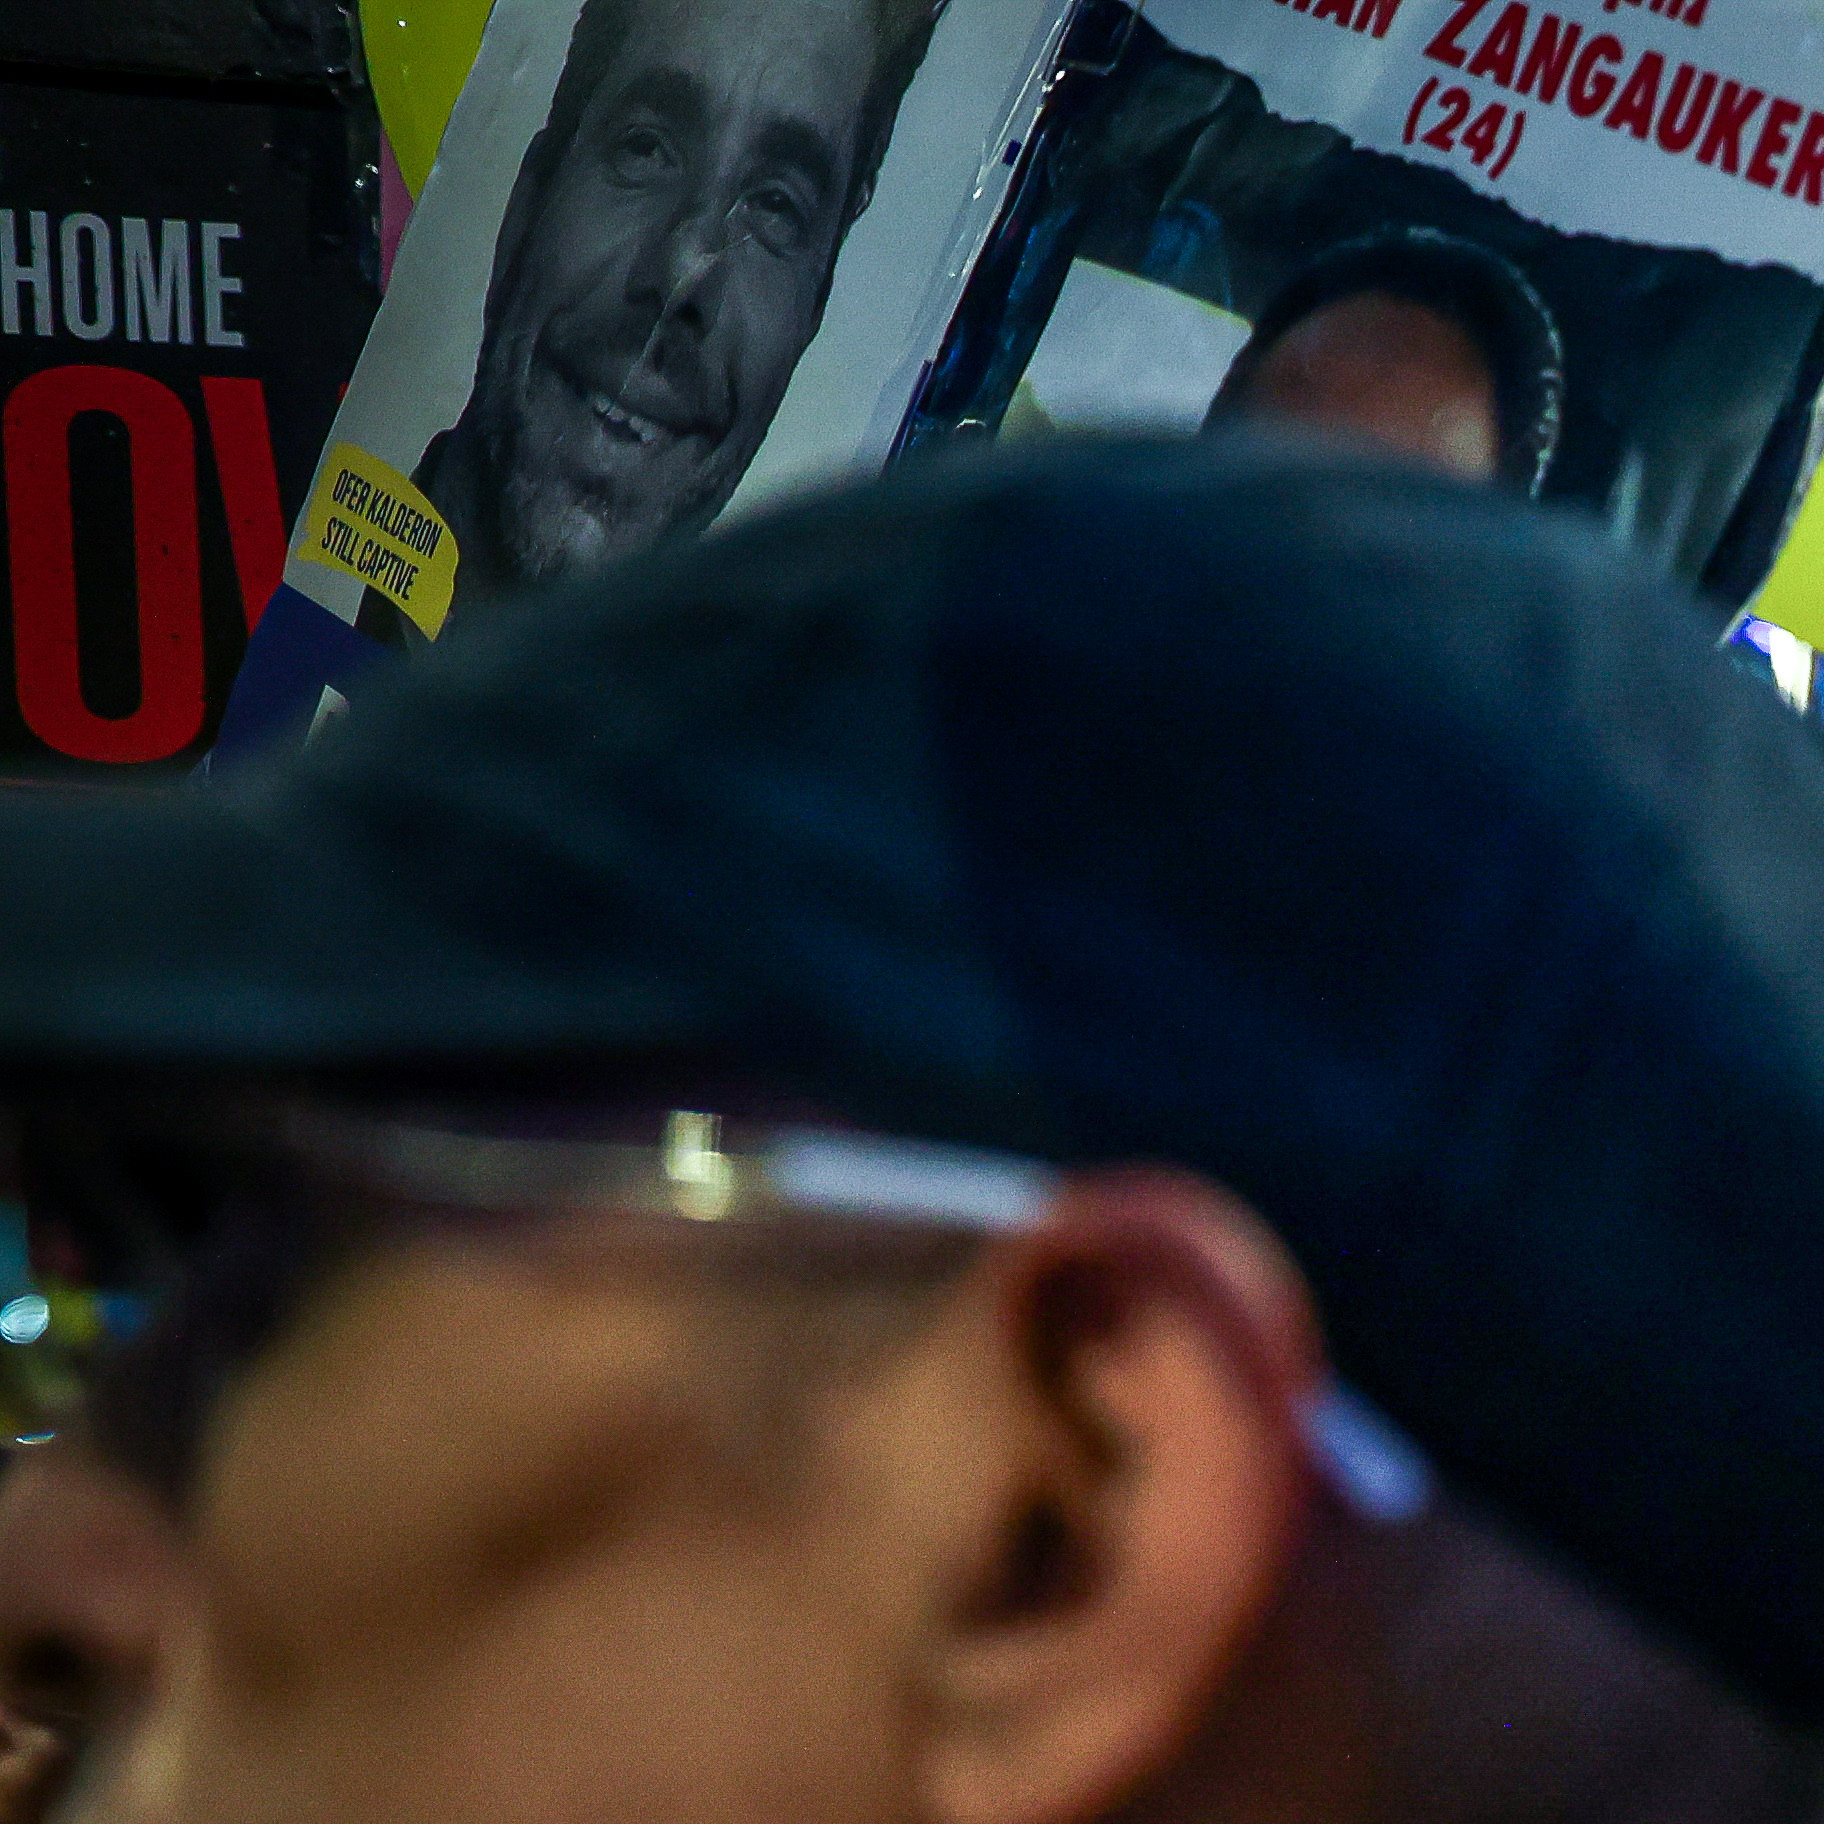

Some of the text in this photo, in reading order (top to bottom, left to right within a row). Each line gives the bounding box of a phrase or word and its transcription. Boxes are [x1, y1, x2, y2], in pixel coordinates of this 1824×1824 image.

[1403, 76, 1527, 180] (24)
[0, 208, 246, 348] HOME
[321, 516, 420, 601] STILL CAPTIVE
[331, 468, 444, 560] OFER KALDERON
